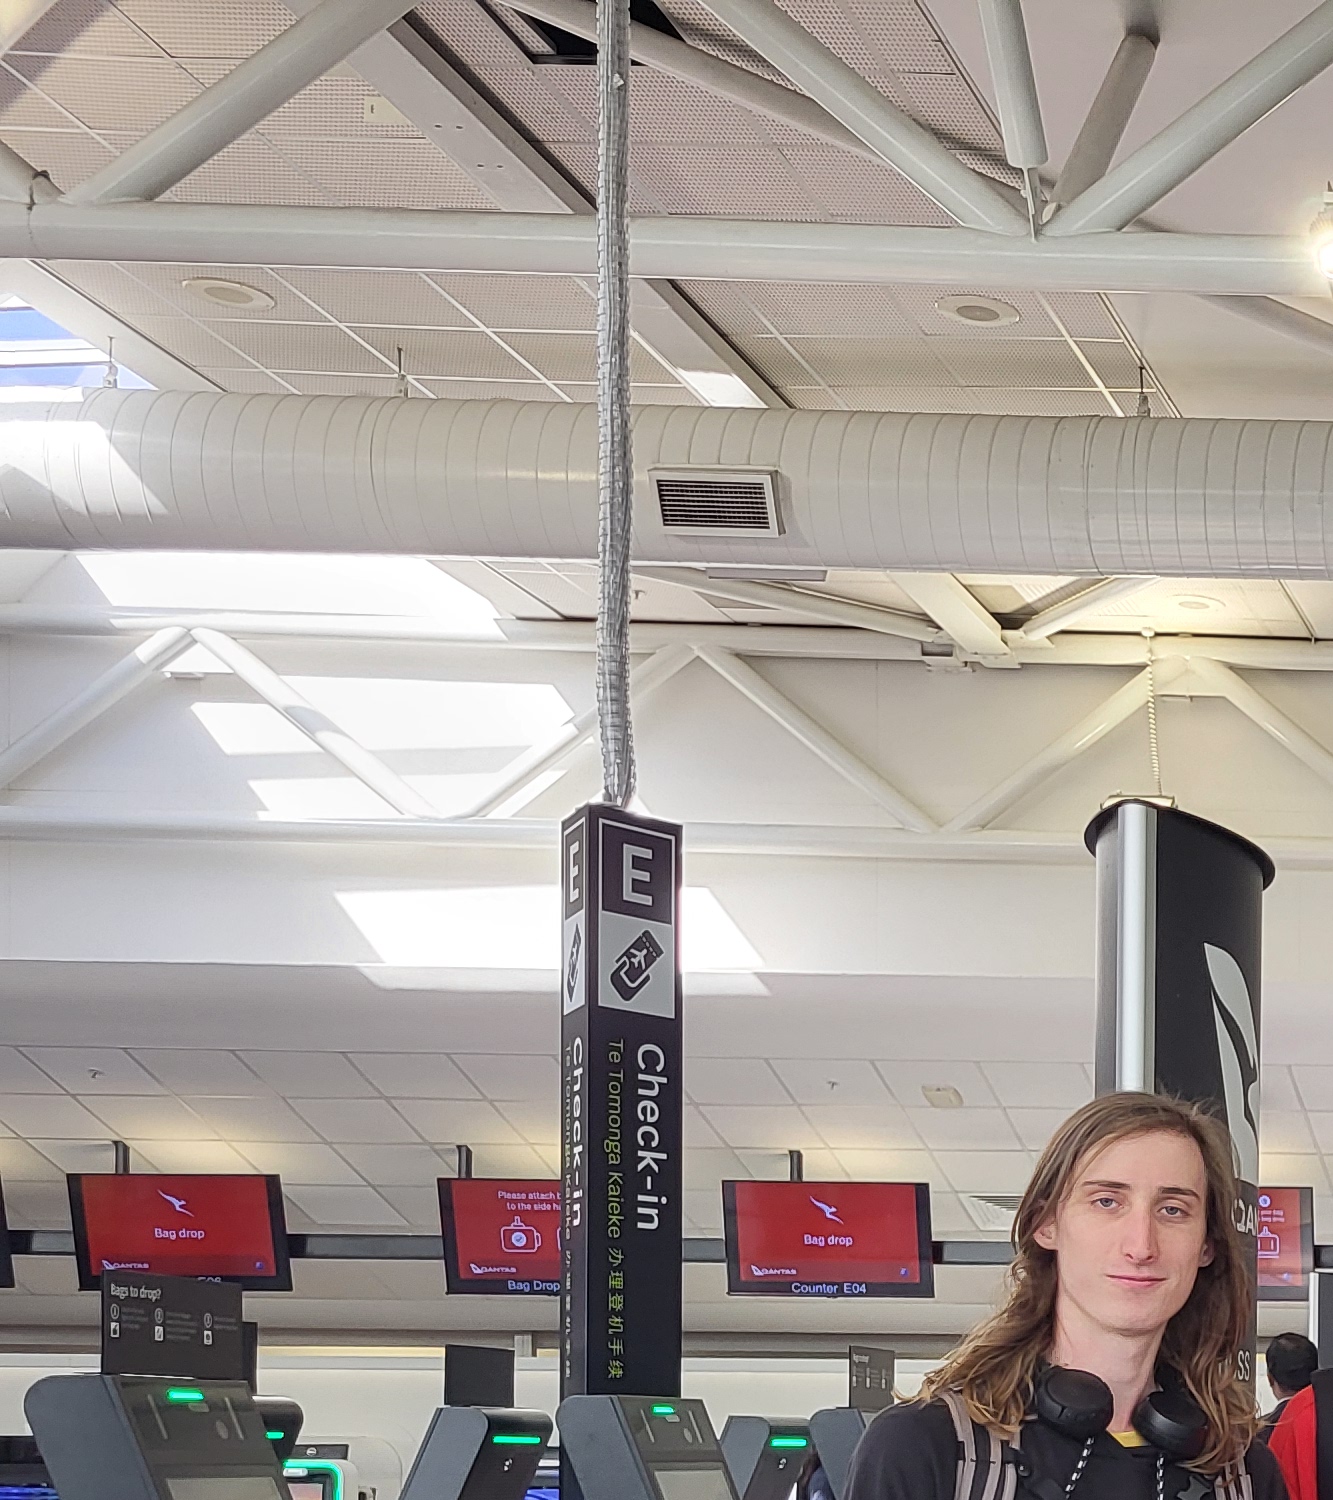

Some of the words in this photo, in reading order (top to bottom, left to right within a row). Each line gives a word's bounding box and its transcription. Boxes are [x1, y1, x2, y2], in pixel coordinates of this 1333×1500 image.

[569, 840, 579, 903] E
[622, 842, 653, 906] E
[608, 1039, 625, 1064] Te
[573, 1036, 583, 1227] Check-in
[603, 1069, 625, 1165] Tomonga
[636, 1043, 668, 1230] Check-in
[154, 1228, 177, 1240] Bag
[178, 1227, 206, 1239] drop
[607, 1171, 625, 1239] Kaieke
[804, 1234, 825, 1247] Bag
[827, 1234, 854, 1247] drop
[110, 1283, 129, 1300] Bags
[507, 1280, 531, 1292] Bag
[533, 1280, 561, 1292] Drop
[607, 1247, 624, 1379] 办理登机手续
[791, 1282, 839, 1295] Counter
[843, 1283, 867, 1294] E04
